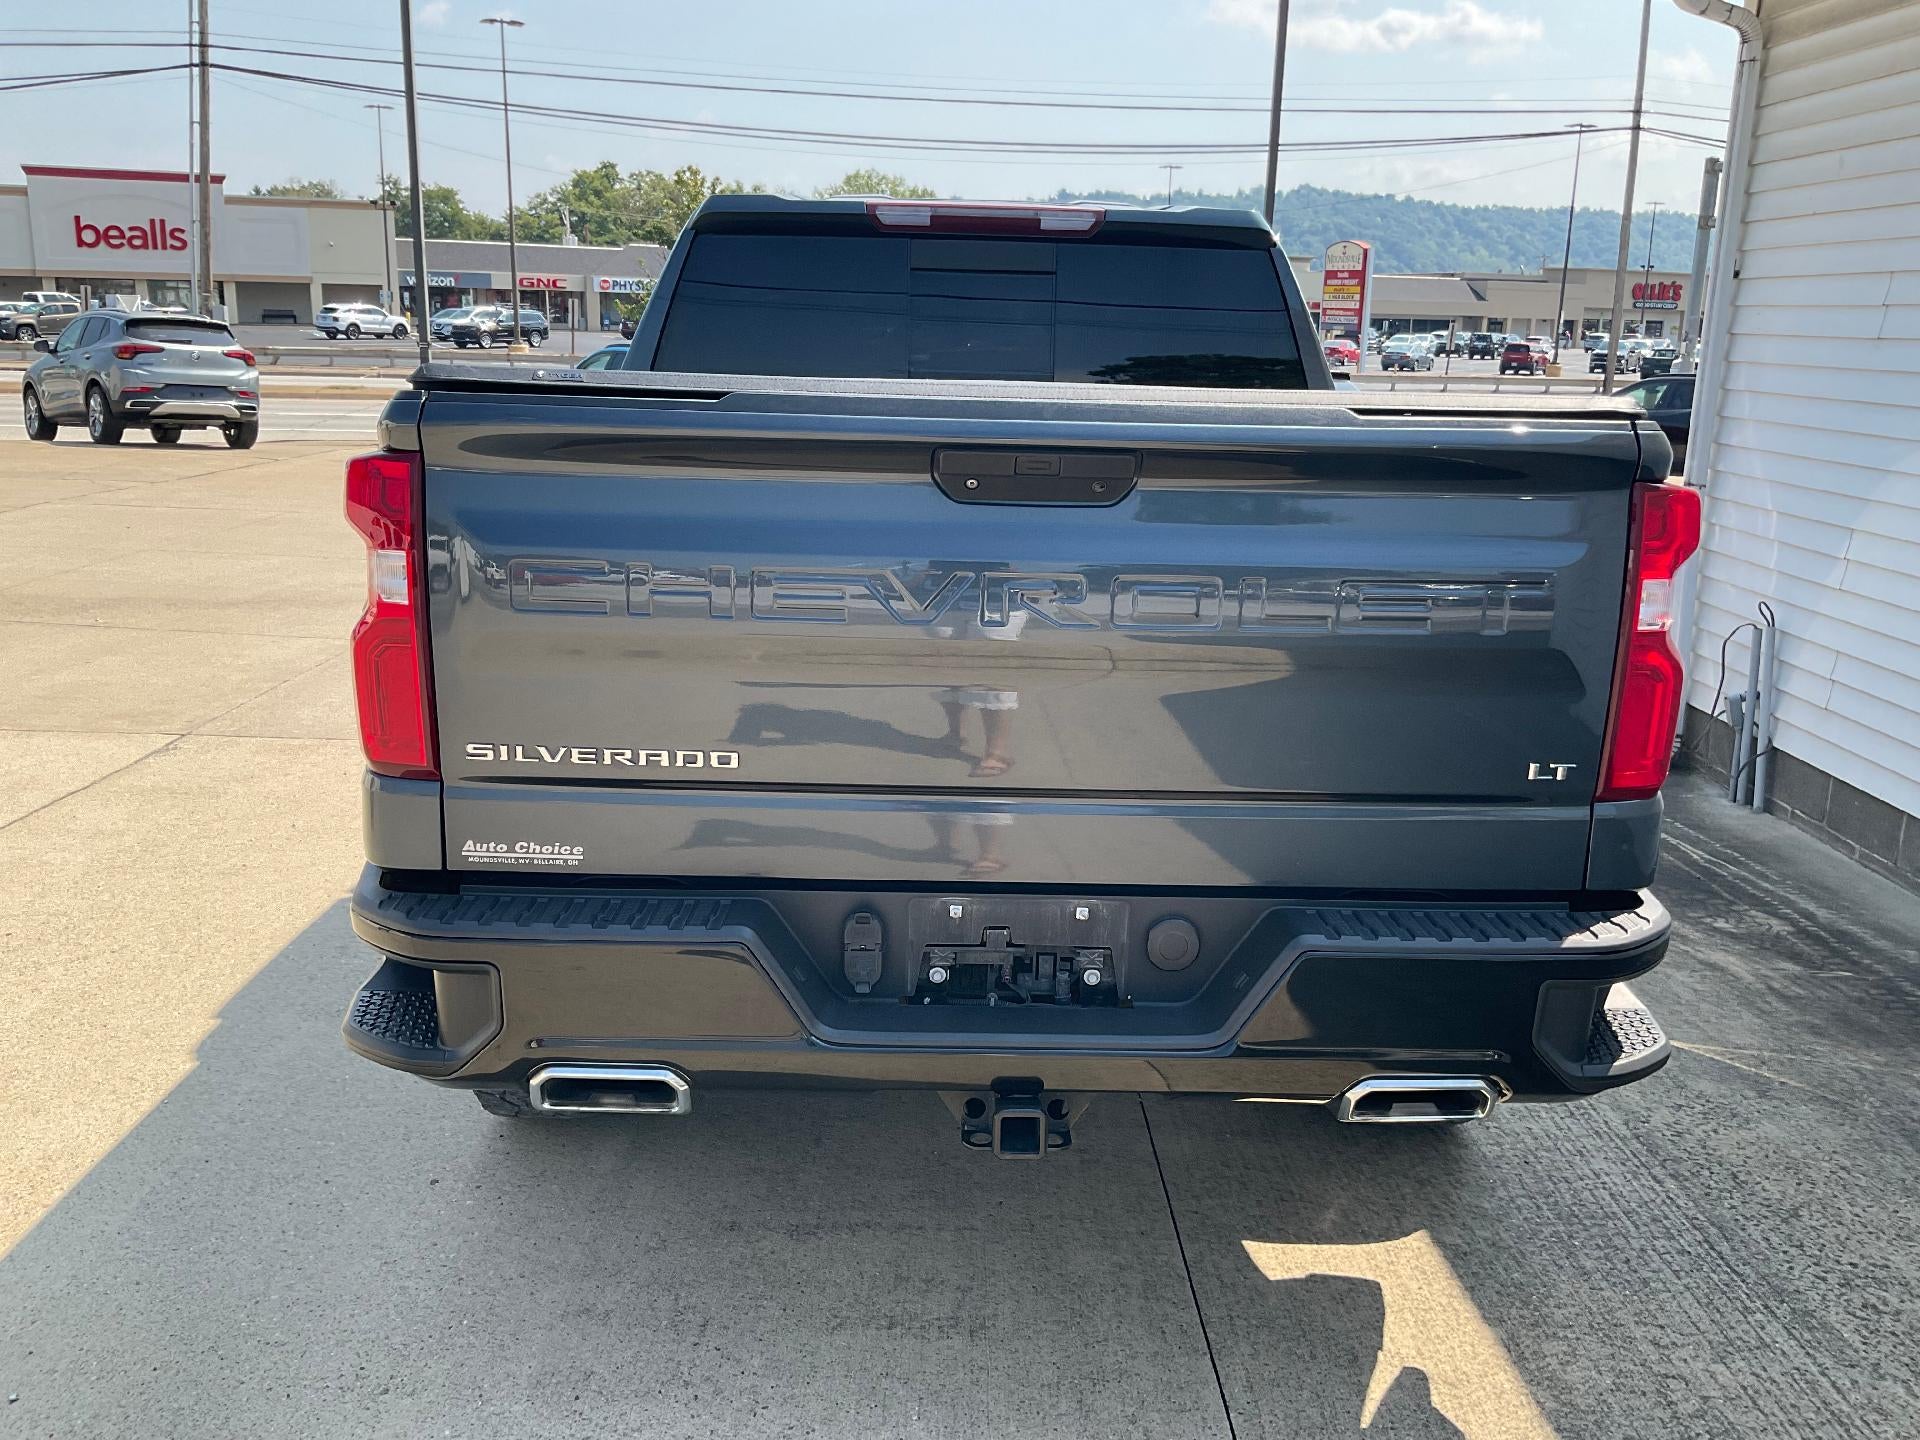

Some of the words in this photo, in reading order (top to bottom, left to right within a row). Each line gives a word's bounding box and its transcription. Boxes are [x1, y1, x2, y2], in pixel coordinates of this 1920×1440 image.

[73, 215, 188, 251] bealls
[406, 274, 455, 286] vizon
[518, 277, 567, 289] GNC
[508, 558, 1555, 636] CHEVROLET
[465, 743, 740, 769] SILVERADO
[1527, 763, 1577, 781] LT
[462, 839, 508, 853] Auto
[514, 841, 584, 855] Choice
